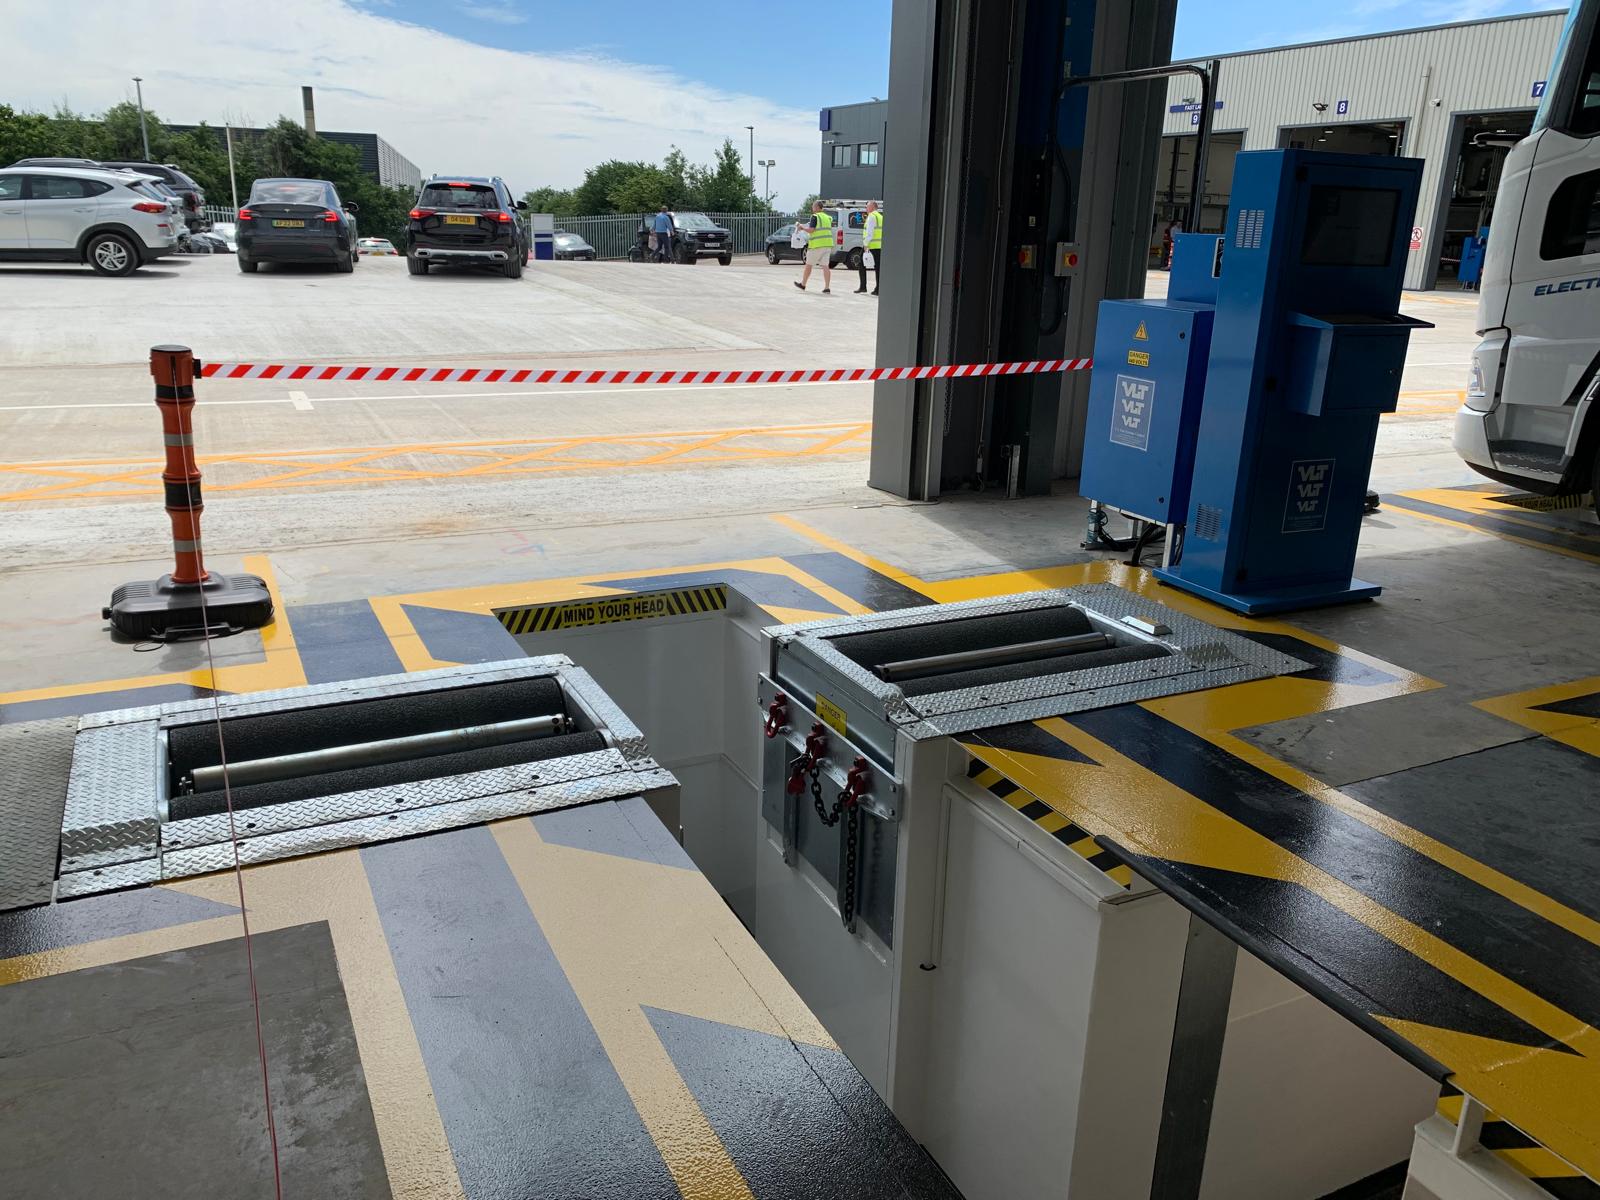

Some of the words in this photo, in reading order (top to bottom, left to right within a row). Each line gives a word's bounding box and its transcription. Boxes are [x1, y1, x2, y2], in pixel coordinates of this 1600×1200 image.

[1536, 83, 1544, 95] 7
[1339, 102, 1346, 112] 8
[1192, 114, 1198, 123] 9
[1129, 351, 1148, 360] DANGER
[1122, 381, 1149, 400] VLT
[1121, 399, 1145, 415] VLT
[1121, 414, 1141, 428] VLT
[1298, 464, 1329, 482] VLT
[1297, 482, 1324, 497] VLT
[1296, 500, 1319, 512] VLT
[564, 607, 595, 623] MIND
[598, 603, 630, 619] YOUR
[634, 599, 664, 615] HEAD
